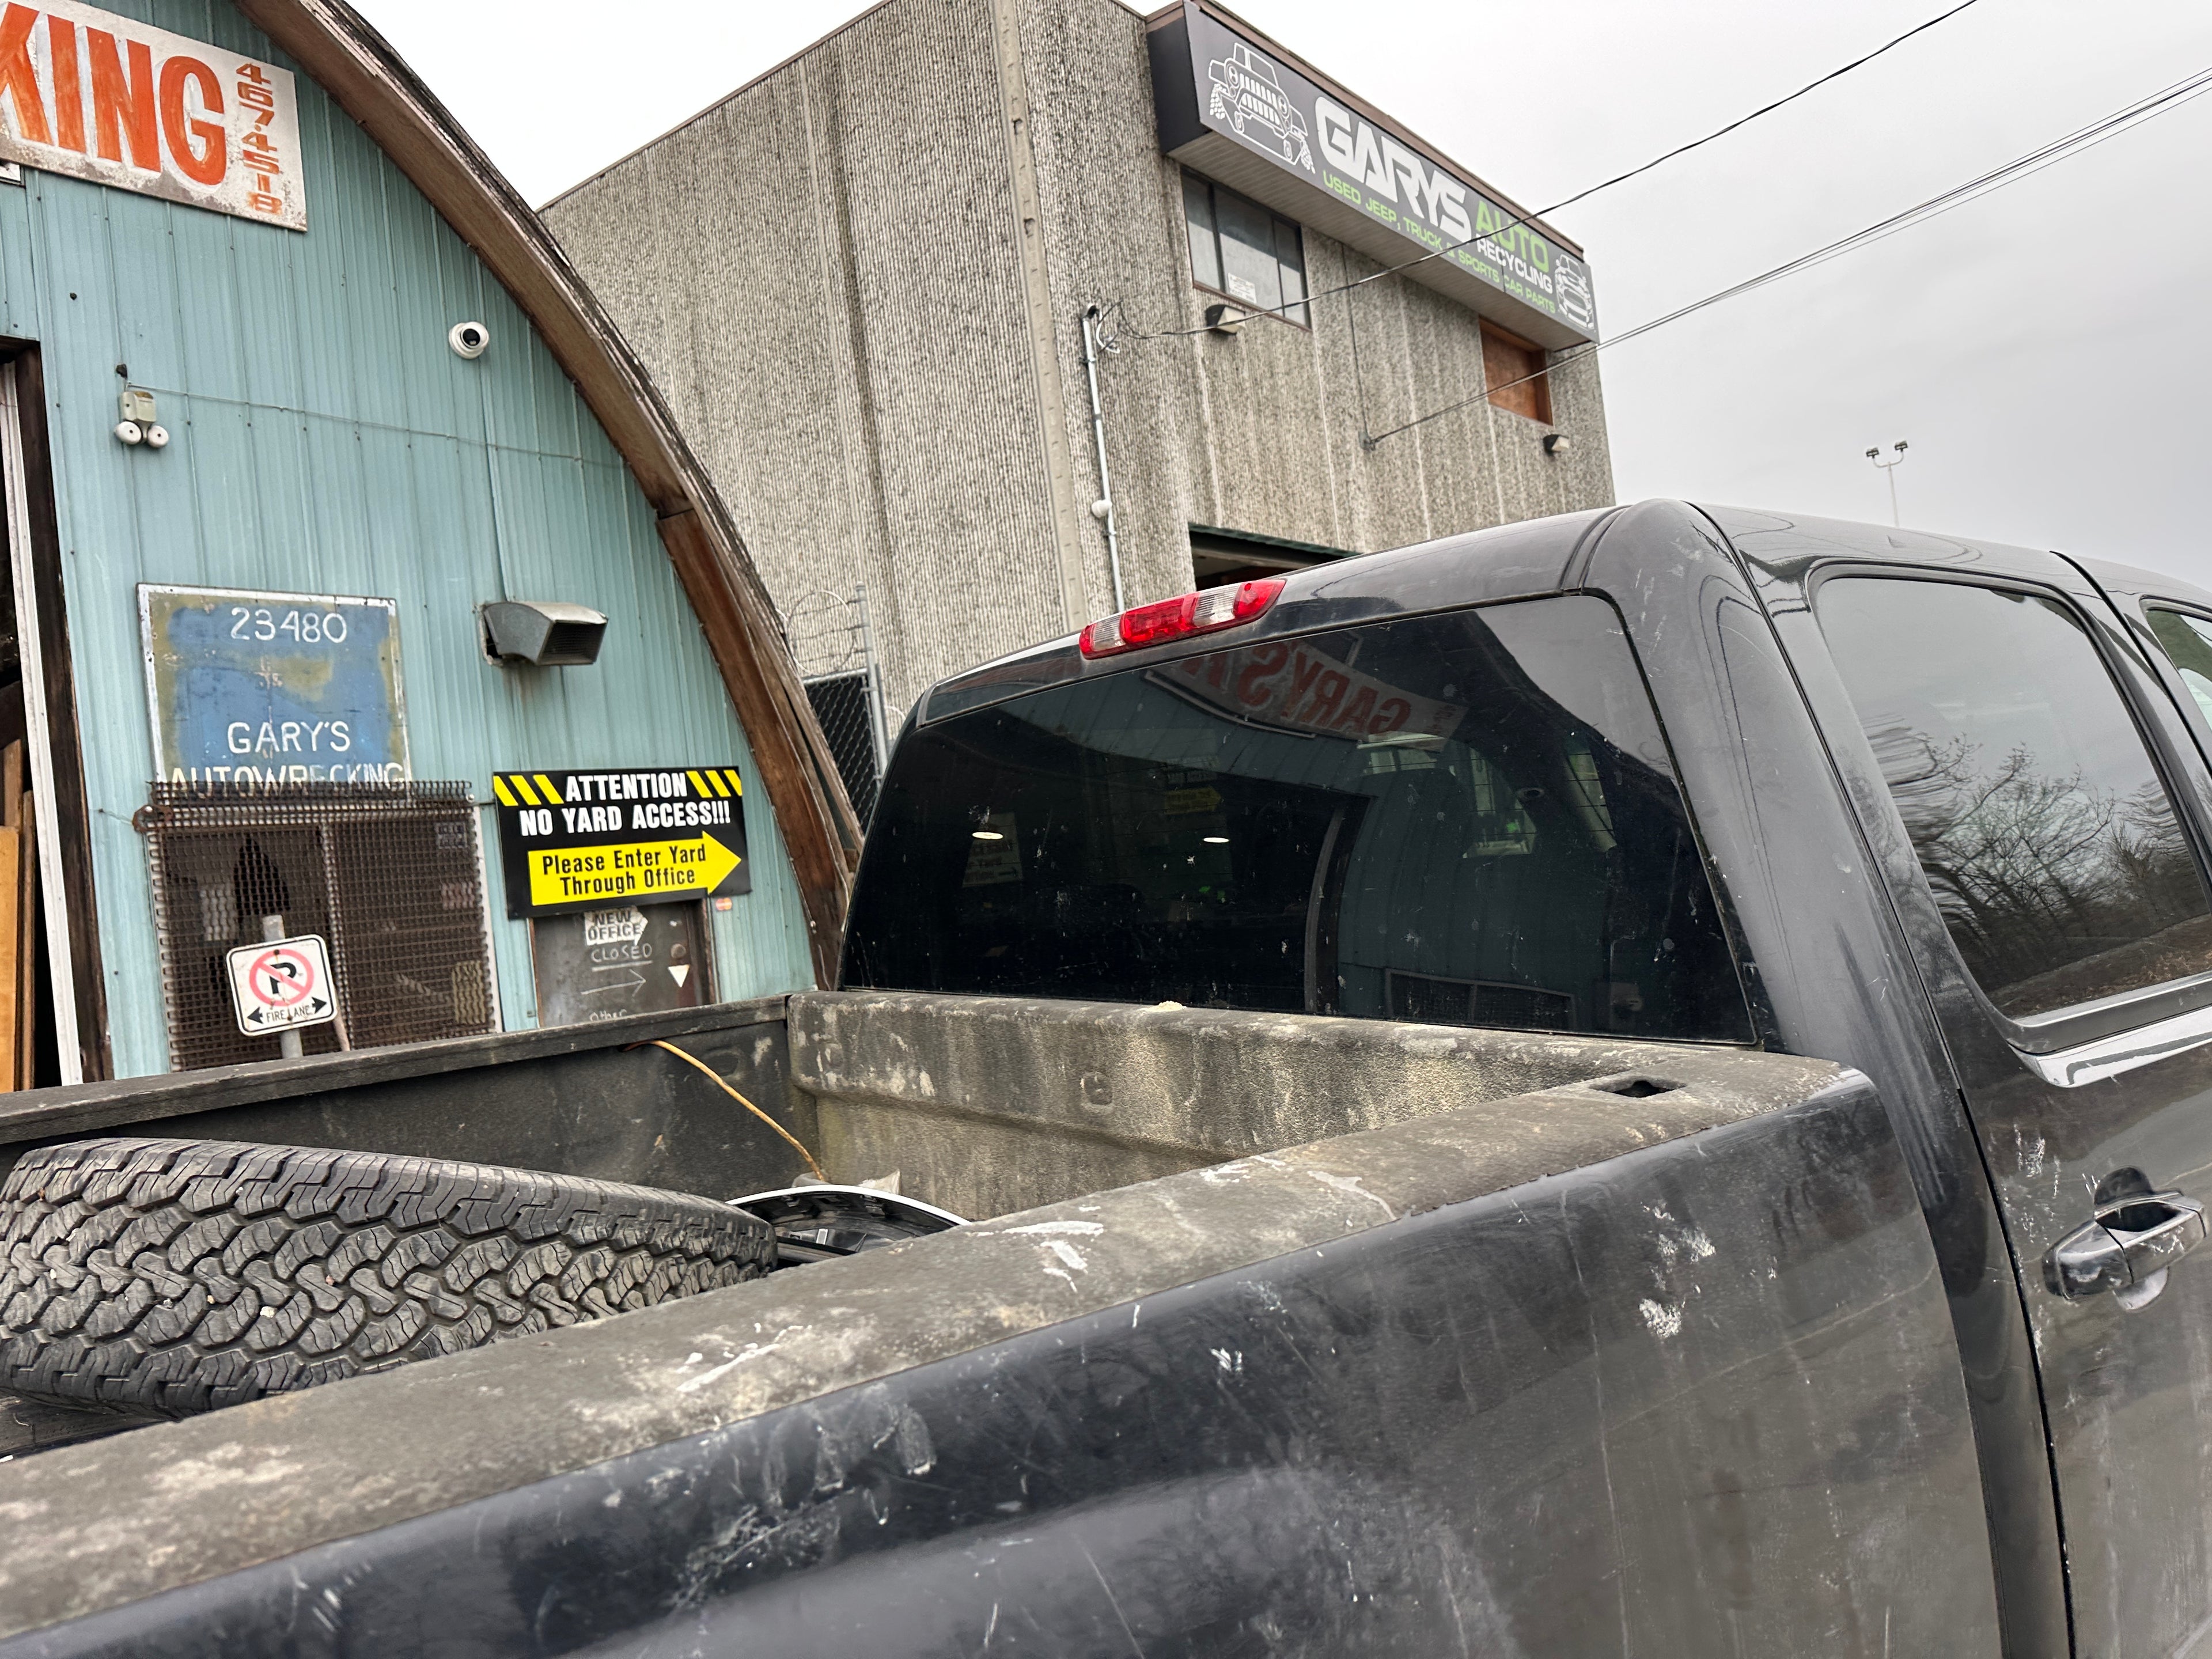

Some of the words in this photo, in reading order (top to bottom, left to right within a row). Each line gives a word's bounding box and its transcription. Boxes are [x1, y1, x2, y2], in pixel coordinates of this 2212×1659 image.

[1315, 96, 1472, 243] GARYS
[1323, 170, 1362, 205] USED
[1403, 217, 1443, 251] TRUCK
[1458, 249, 1500, 283] SPORTS
[1503, 274, 1524, 297] CAR
[1526, 287, 1556, 314] PARTS
[1476, 200, 1550, 274] AUTO
[1476, 233, 1553, 294] RECYCLING
[230, 607, 347, 644] 23480
[227, 721, 351, 754] GARY'S
[566, 772, 688, 802] ATTENTION
[519, 809, 553, 836] NO
[562, 806, 623, 834] YARD
[632, 800, 731, 830] ACCESS!!!
[542, 855, 605, 875] Please
[613, 850, 661, 869] Enter
[669, 843, 707, 865] Yard
[560, 872, 636, 896] Through
[644, 868, 695, 888] Office
[588, 923, 642, 941] OFFICE
[594, 910, 631, 925] NEW
[591, 943, 653, 963] CLOSED
[266, 1009, 286, 1023] FIRE
